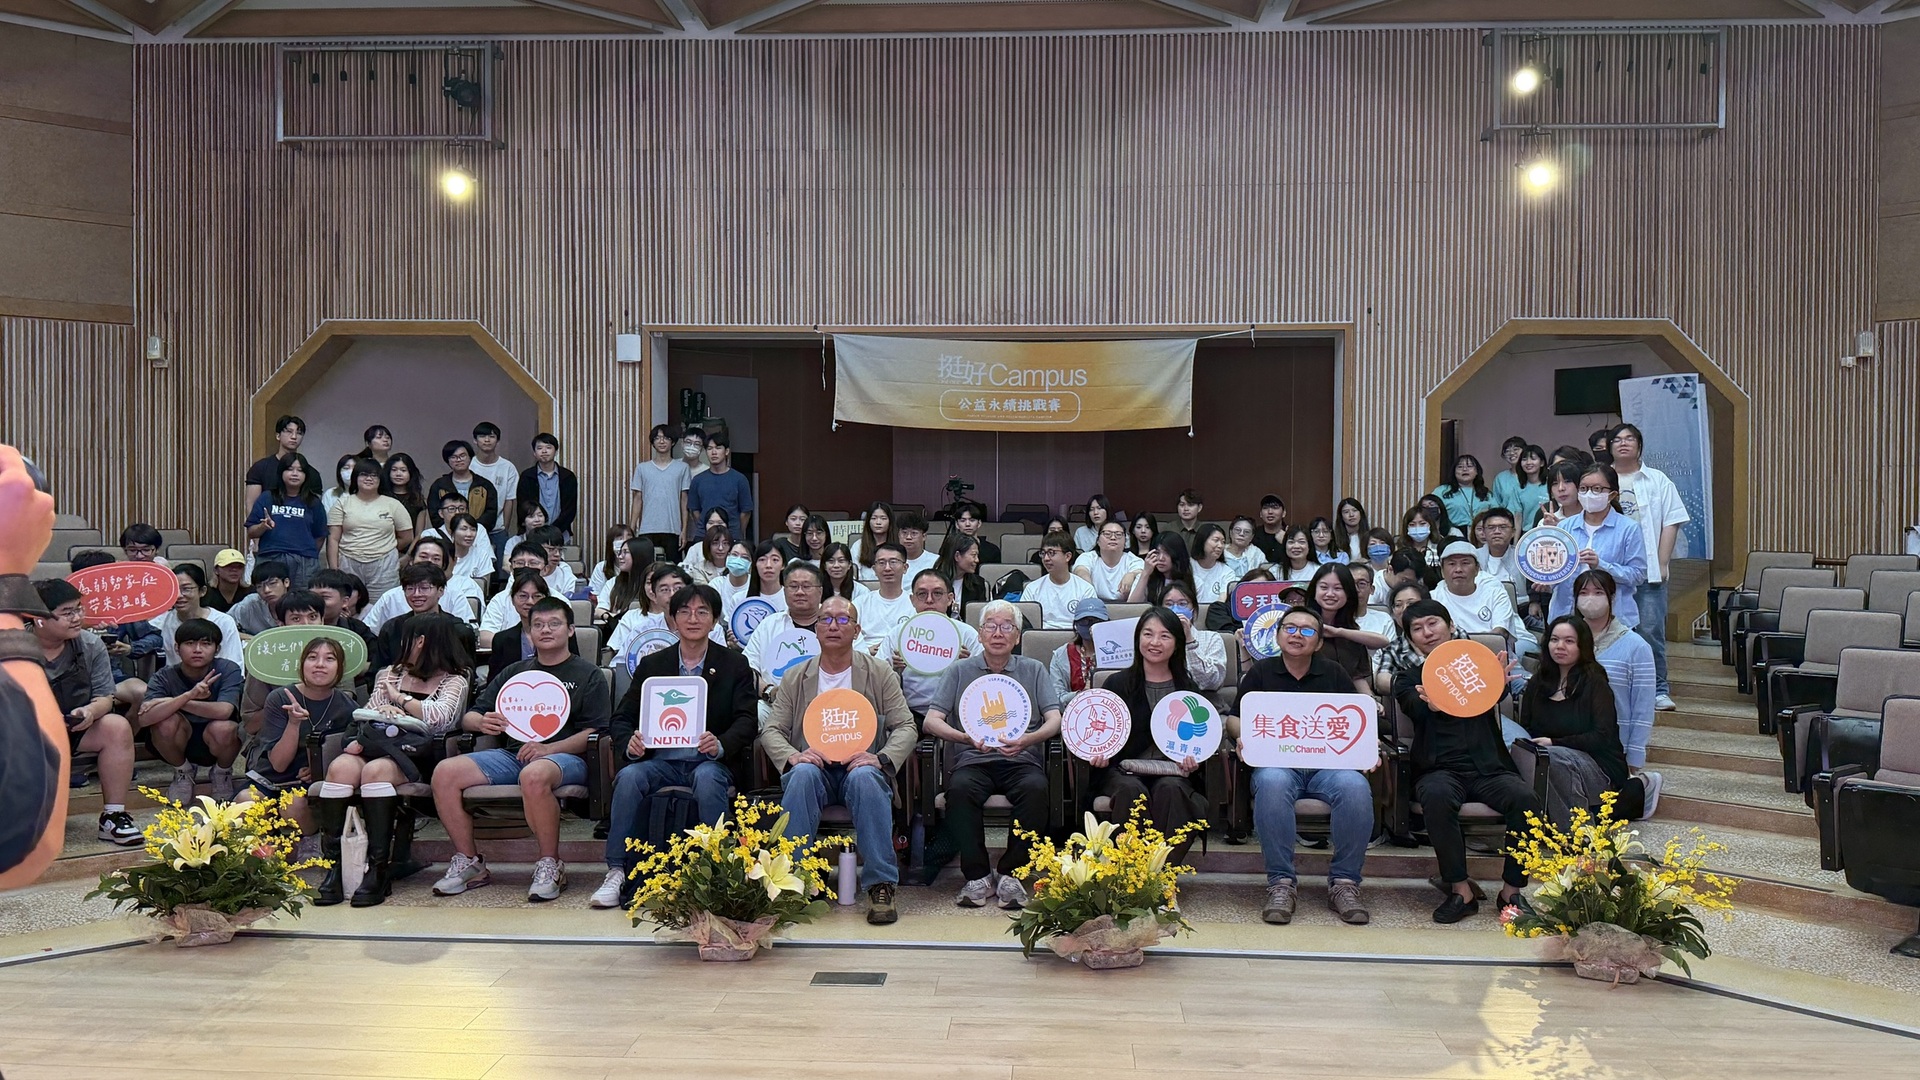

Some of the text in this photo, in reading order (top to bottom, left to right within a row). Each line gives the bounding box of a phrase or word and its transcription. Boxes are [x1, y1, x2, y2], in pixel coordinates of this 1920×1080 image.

[958, 397, 1062, 413] 公益永續挑戰賽
[271, 504, 305, 518] NSYSU
[1520, 560, 1574, 581] PROVIDENCE UNIVERSITY
[78, 572, 158, 595] 為弱勢家庭
[88, 592, 151, 615] 帶來溫暖
[909, 626, 935, 641] NPO
[906, 639, 953, 658] Channel
[1450, 653, 1487, 694] 挺好
[1435, 666, 1468, 706] Campus
[820, 707, 860, 729] 挺好
[1100, 698, 1123, 733] UNIVERSITY
[1252, 713, 1351, 741] 集食送愛
[653, 736, 691, 745] NUTN
[820, 731, 863, 744] Campus
[1089, 733, 1120, 753] TAMKANG
[1278, 744, 1327, 754] NPOChannel
